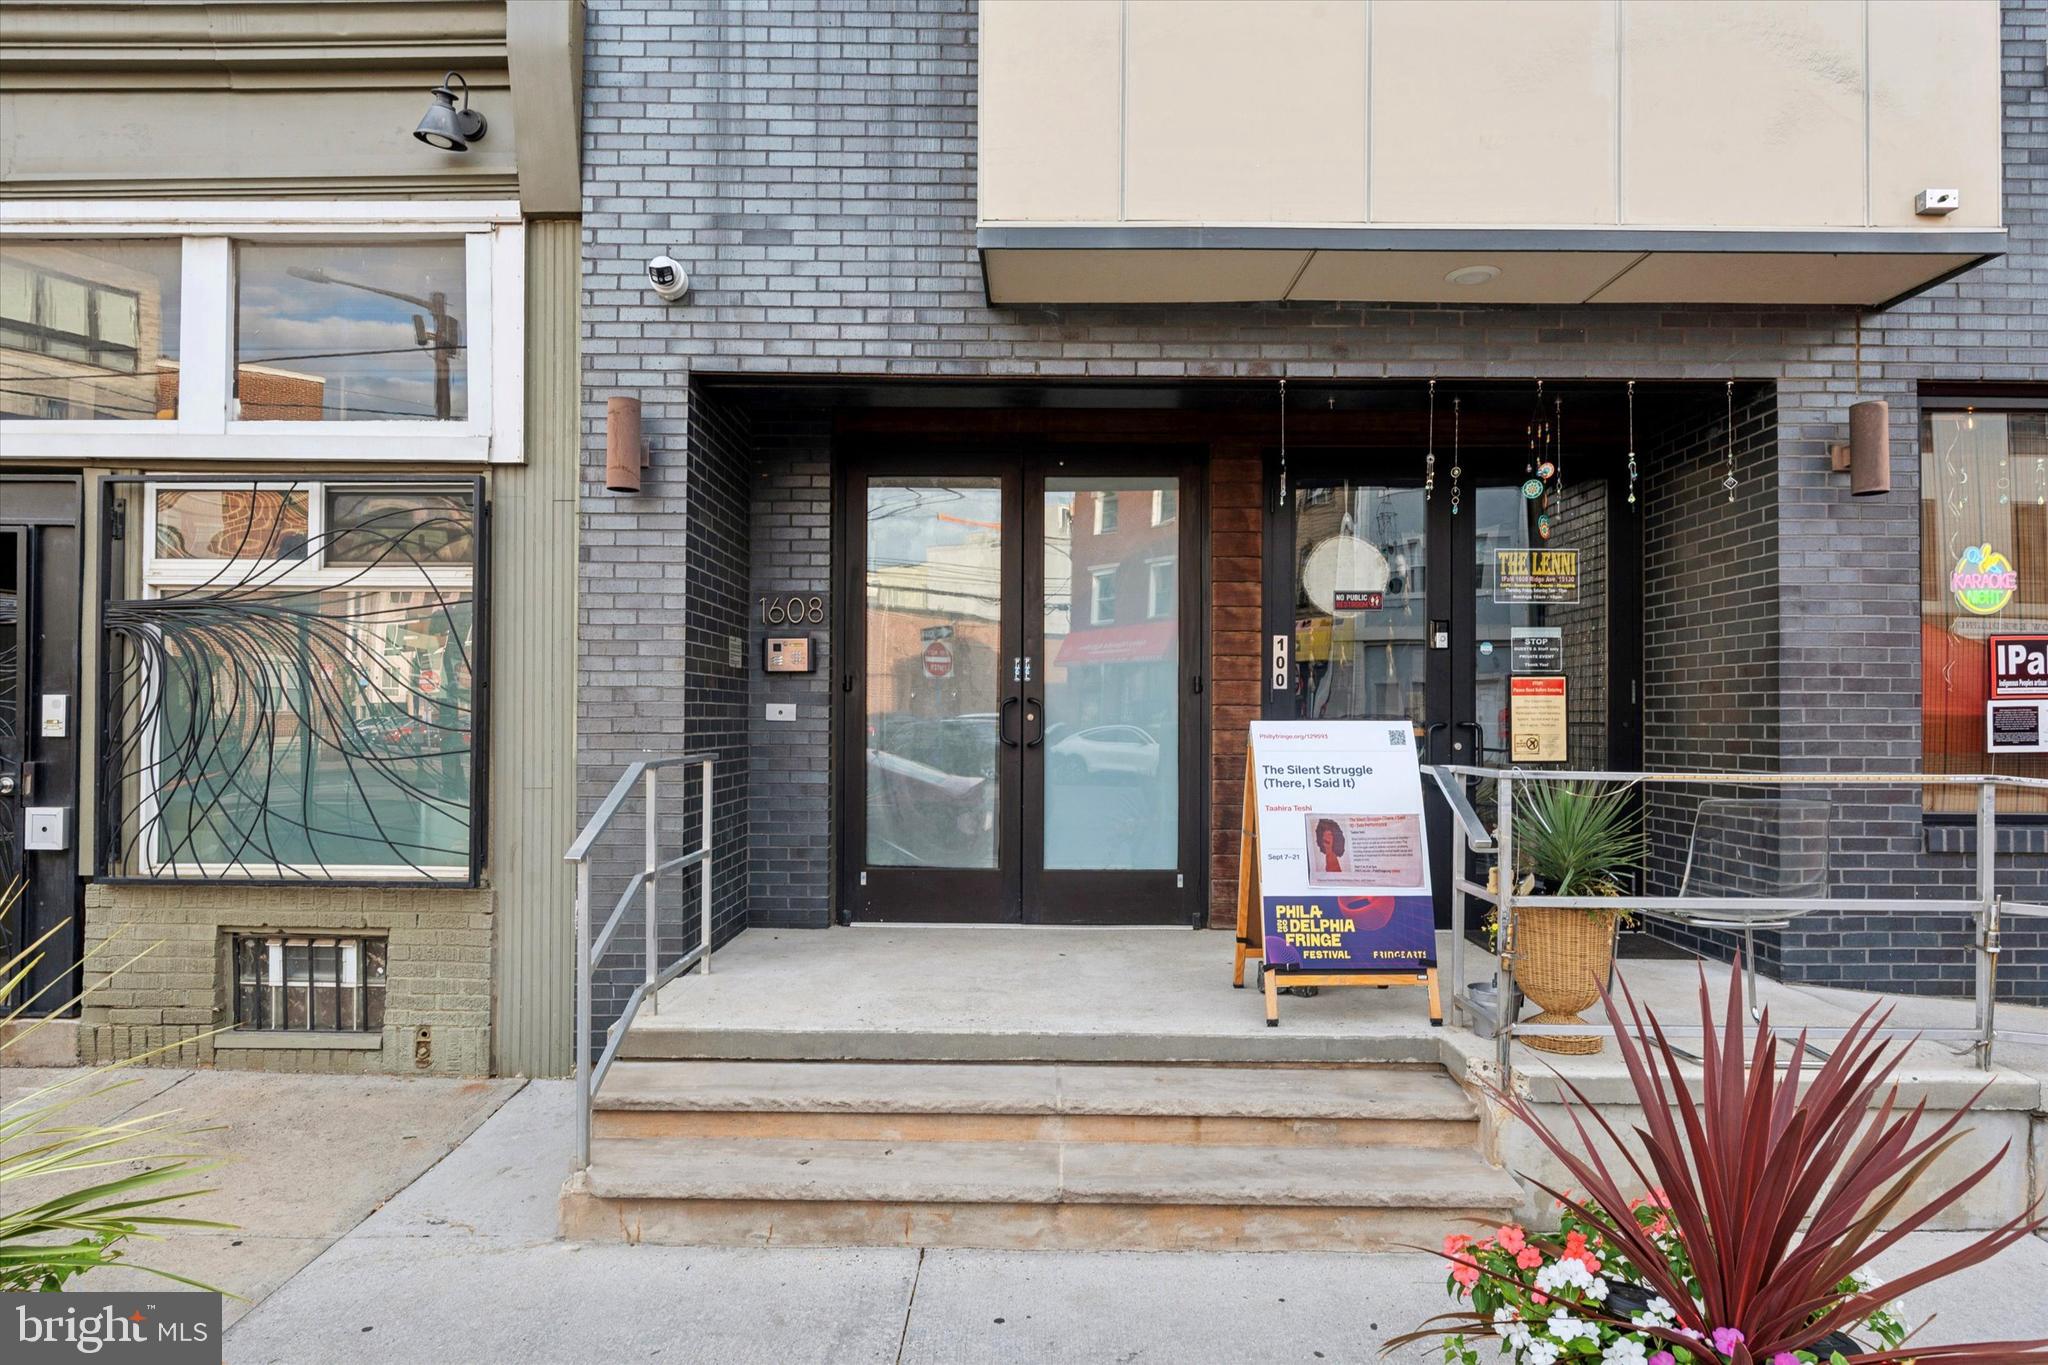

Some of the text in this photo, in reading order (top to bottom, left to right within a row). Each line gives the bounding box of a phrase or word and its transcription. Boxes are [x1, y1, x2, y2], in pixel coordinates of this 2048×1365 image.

[1498, 552, 1576, 575] THE LENNI
[1952, 574, 2017, 589] KARAOKE
[1967, 590, 2002, 605] NIGHT
[760, 597, 824, 624] 1608
[1276, 638, 1284, 686] 100
[1997, 645, 2048, 675] IPa
[1998, 679, 2018, 688] Indigenous
[2019, 679, 2033, 688] Peoples
[1262, 765, 1373, 776] The Silent Struggle
[1264, 778, 1355, 789] (There, I Said It)
[1290, 919, 1356, 932] DELPHIA
[1286, 934, 1342, 947] FRINGE
[1304, 950, 1351, 959] FESTIVAL
[1373, 951, 1427, 959] FRINGEARTS
